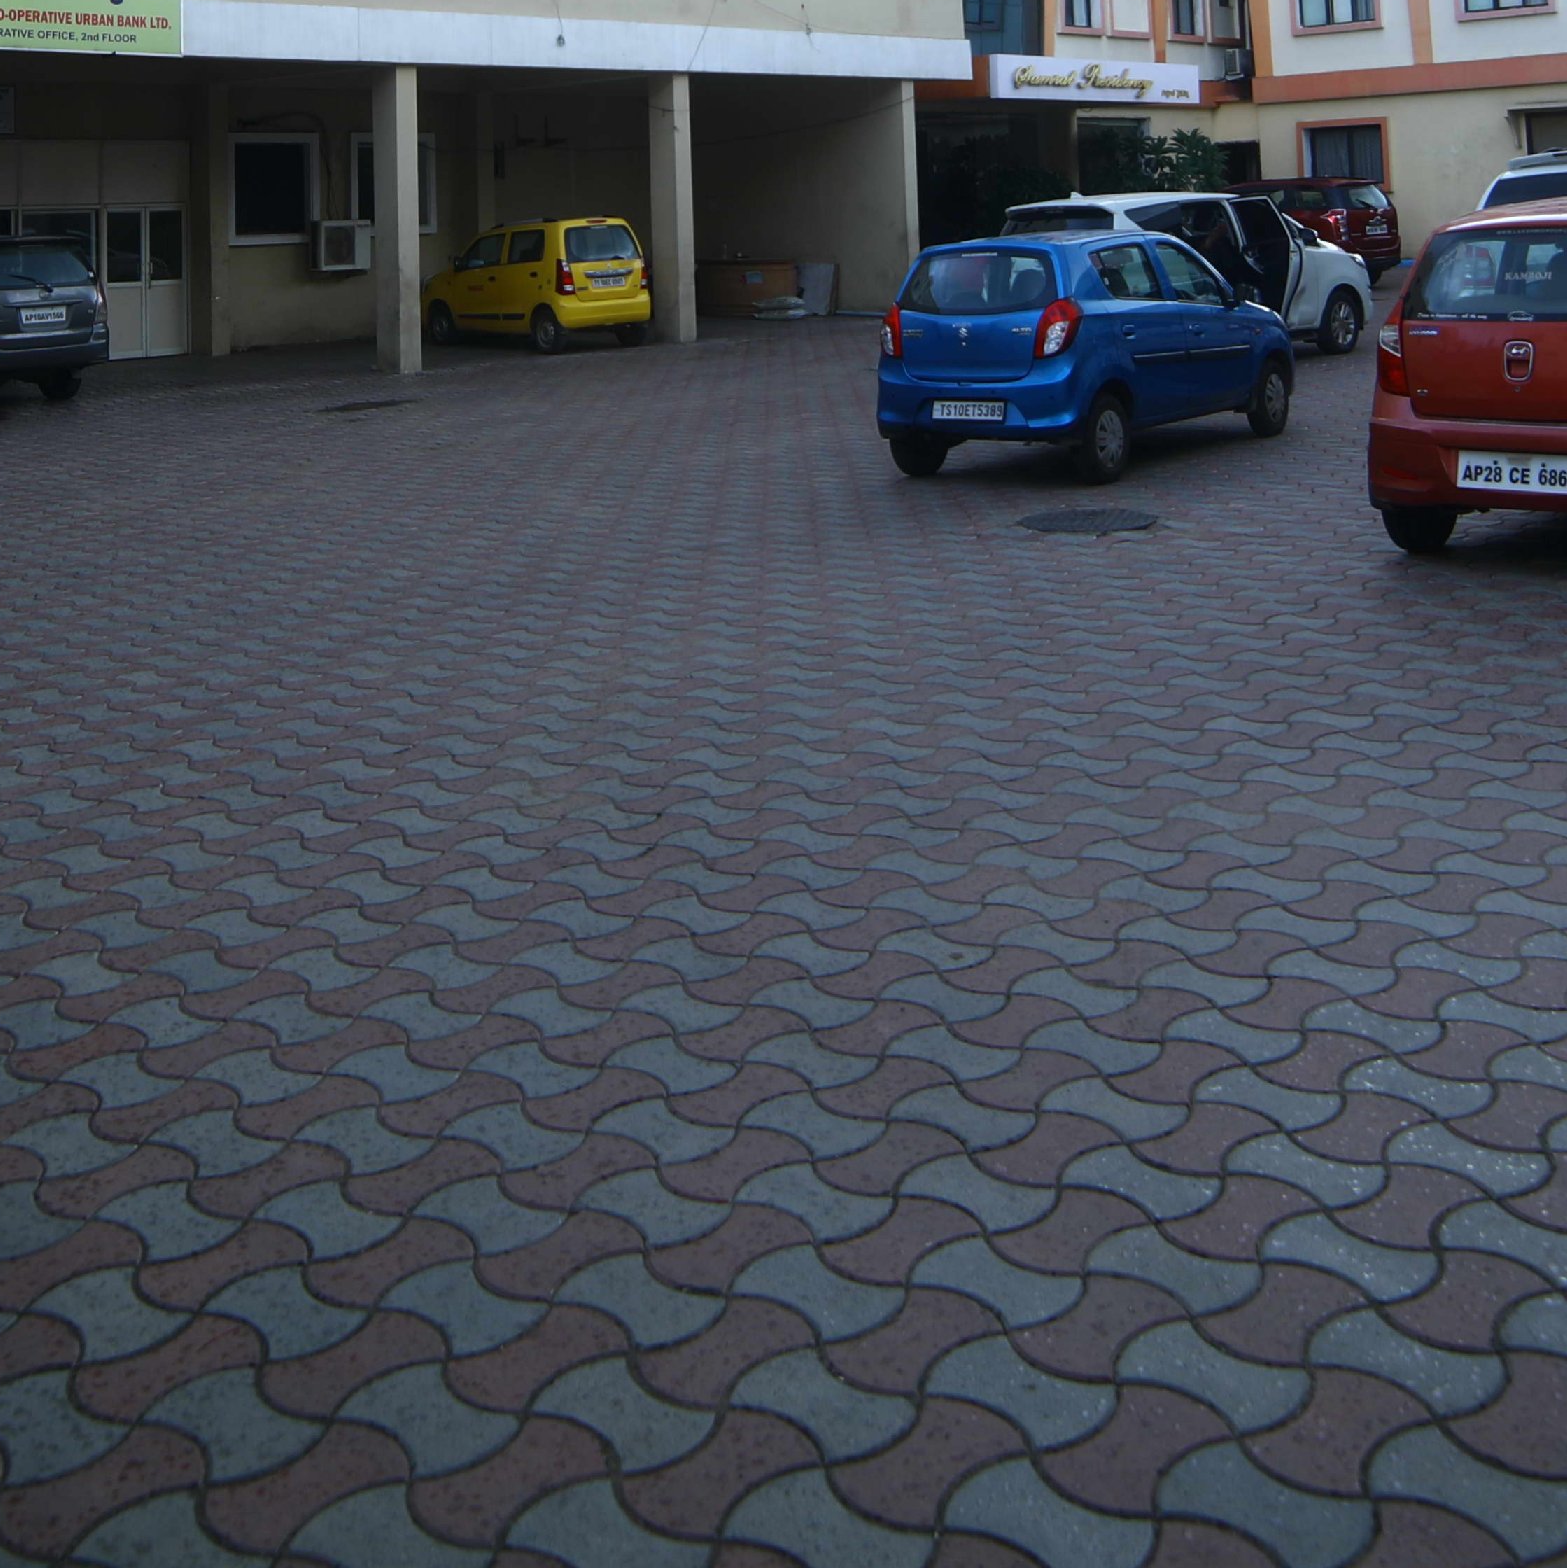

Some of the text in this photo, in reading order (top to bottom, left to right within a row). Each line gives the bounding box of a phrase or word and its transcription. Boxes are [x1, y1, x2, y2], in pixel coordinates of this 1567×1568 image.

[75, 12, 114, 27] URBAN
[117, 14, 147, 28] BANK
[150, 16, 172, 30] LTD.
[37, 30, 79, 42] OFFICE,
[80, 31, 100, 43] 2nd
[103, 33, 137, 44] FLOOR
[1462, 463, 1503, 484] AP28
[1509, 466, 1531, 486] CE
